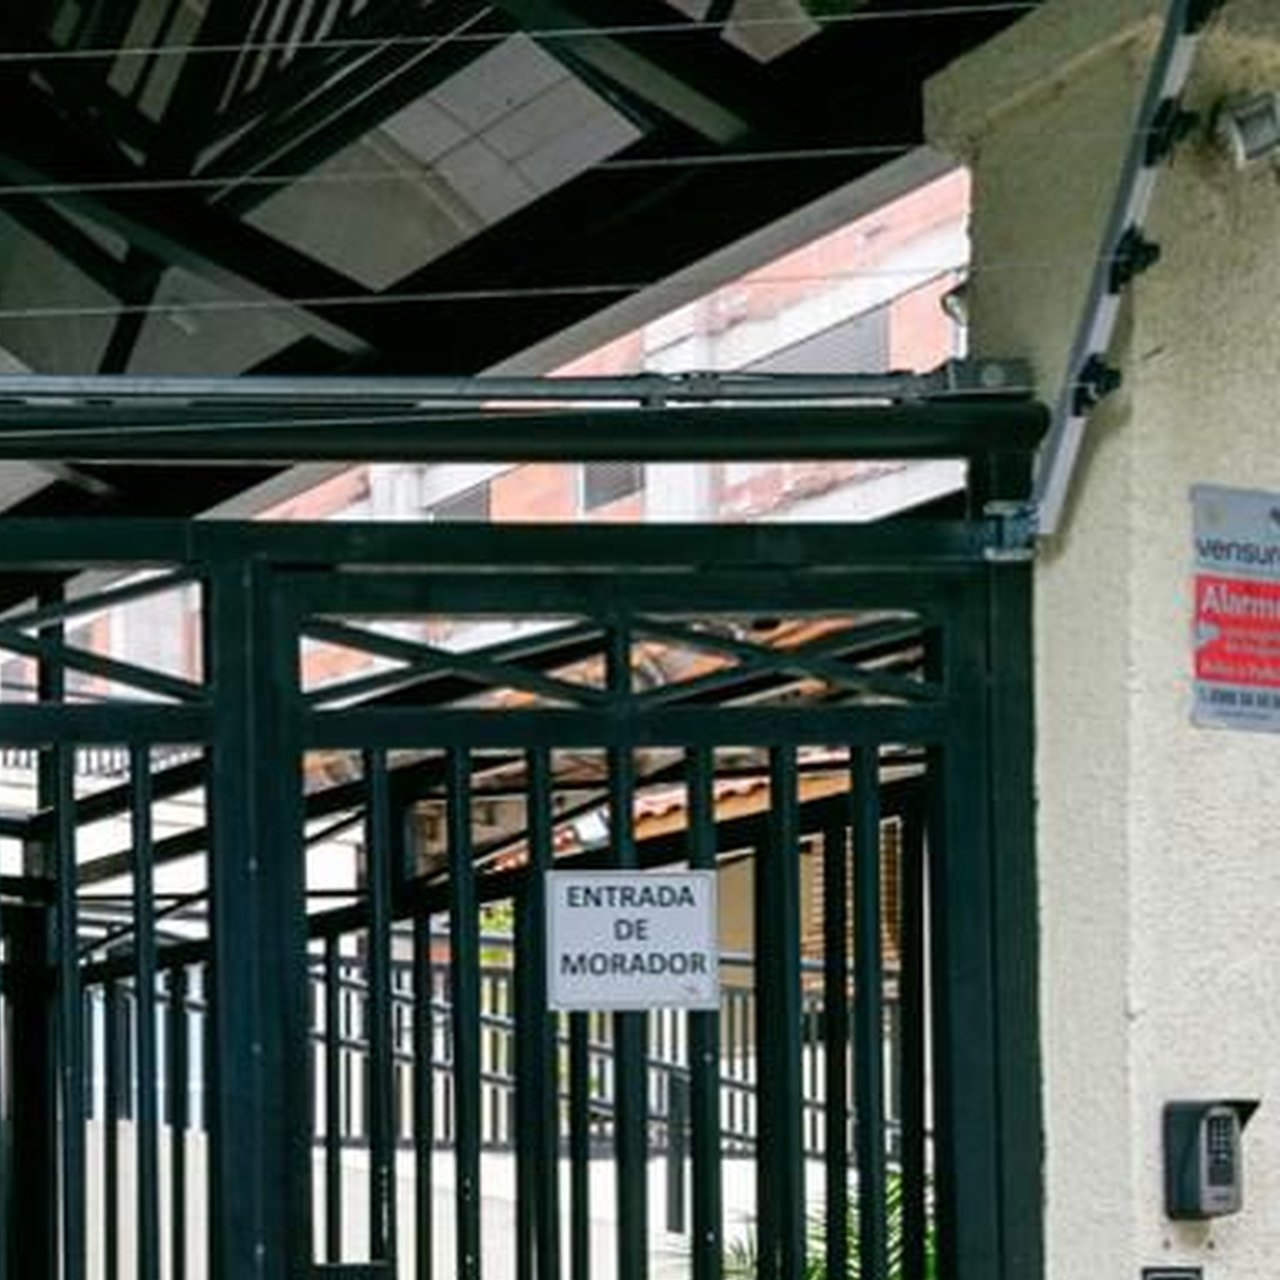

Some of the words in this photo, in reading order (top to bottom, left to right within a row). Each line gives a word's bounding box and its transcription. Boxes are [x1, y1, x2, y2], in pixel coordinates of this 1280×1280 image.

[1196, 539, 1280, 565] verisu
[1200, 583, 1280, 618] Alarm
[566, 885, 697, 908] ENTRADA
[613, 919, 649, 941] DE
[560, 953, 708, 976] MORADOR
